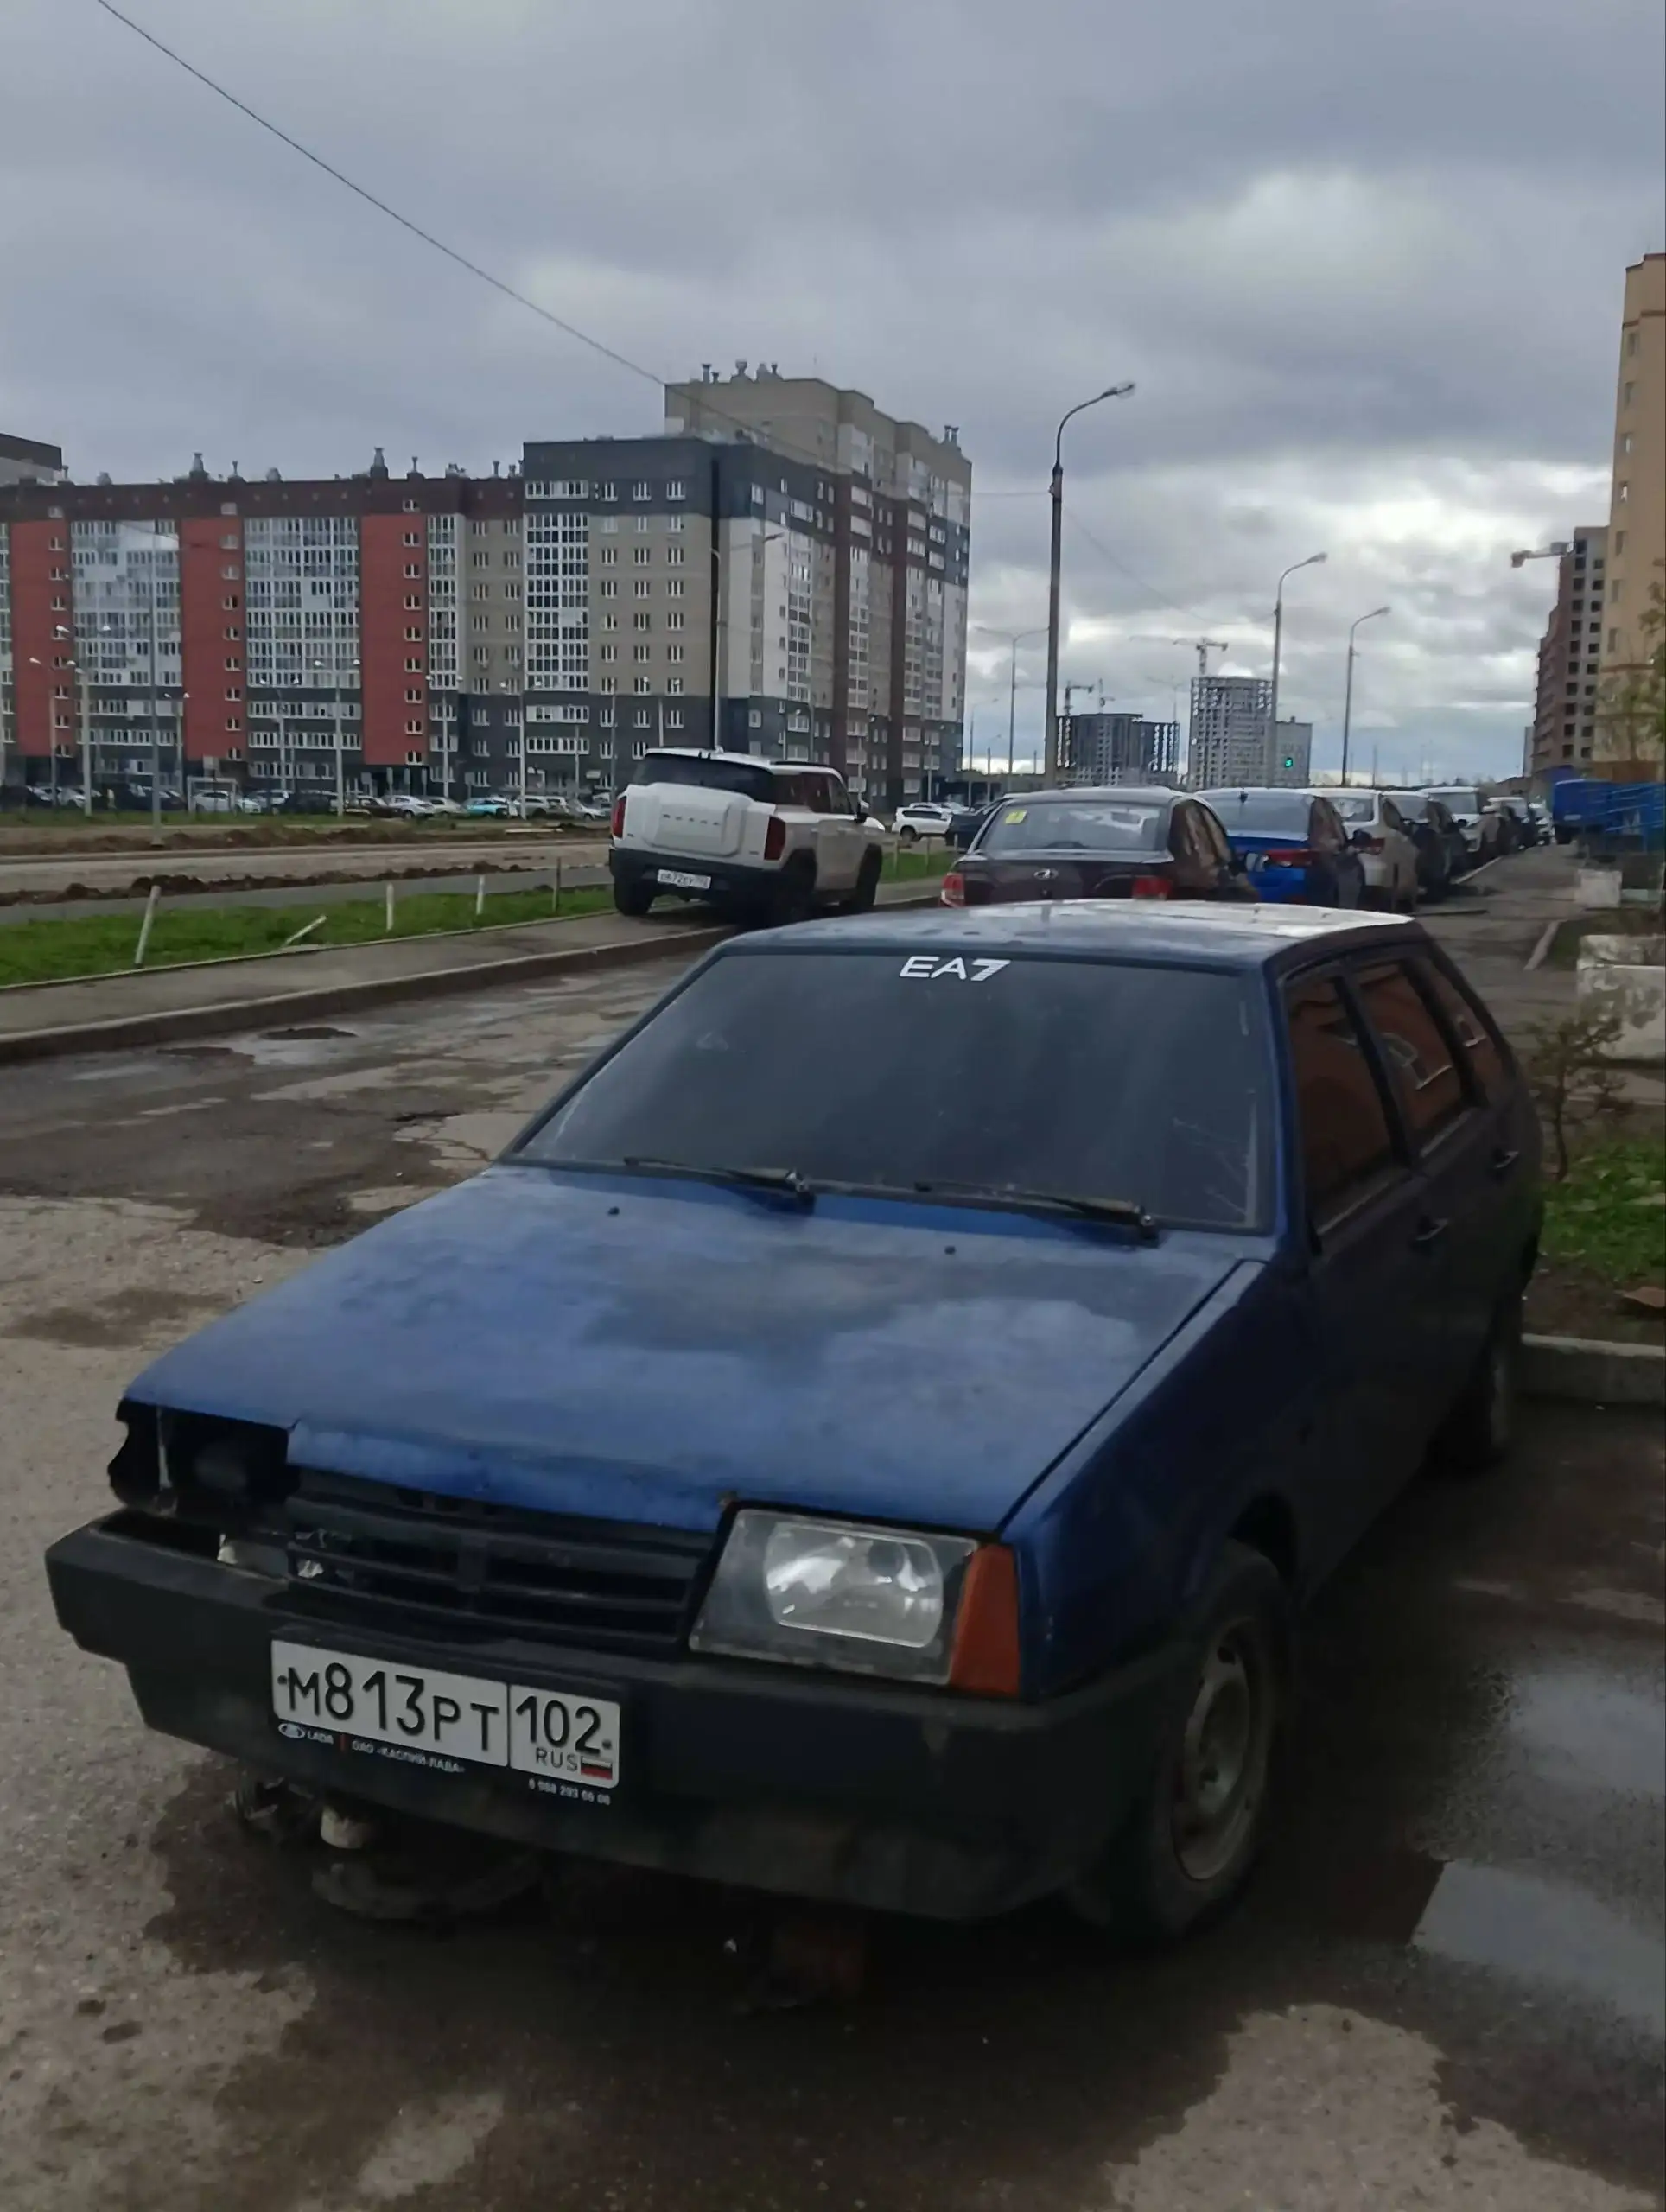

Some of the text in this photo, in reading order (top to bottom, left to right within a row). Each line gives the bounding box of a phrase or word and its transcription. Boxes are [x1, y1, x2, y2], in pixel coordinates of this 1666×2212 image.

[899, 956, 1011, 982] EA7
[288, 1662, 601, 1754] М813РТ 102
[536, 1747, 578, 1772] RUS
